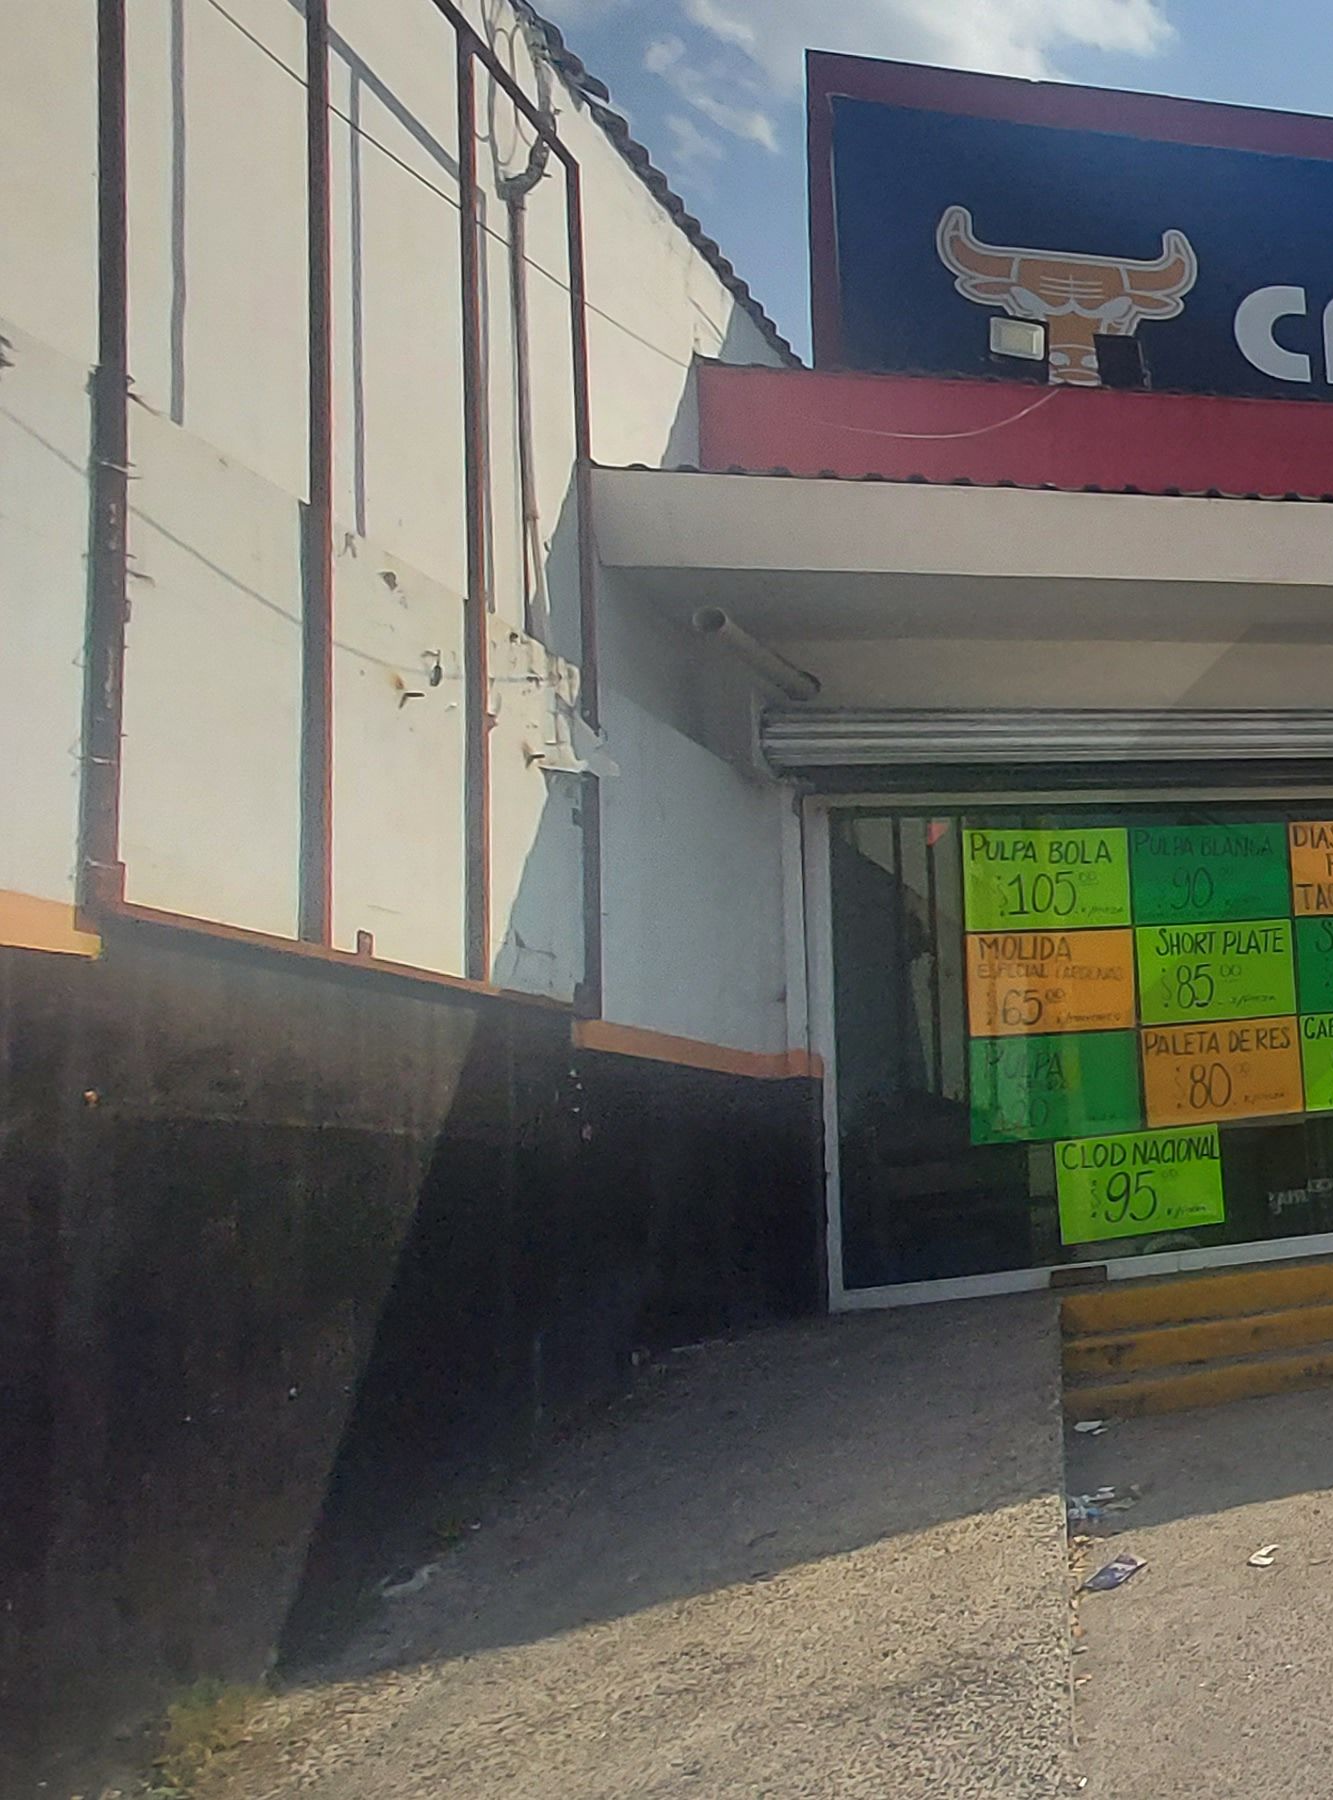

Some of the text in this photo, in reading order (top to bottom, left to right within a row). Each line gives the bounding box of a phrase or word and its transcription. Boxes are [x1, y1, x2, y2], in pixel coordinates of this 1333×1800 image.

[969, 832, 1113, 864] PULPA BOLA
[978, 936, 1073, 962] MOLIDA
[1155, 927, 1285, 957] SHORT PLATE
[1143, 1026, 1291, 1055] PALETA DE RES
[1061, 1135, 1221, 1170] CLOD NACIONAL
